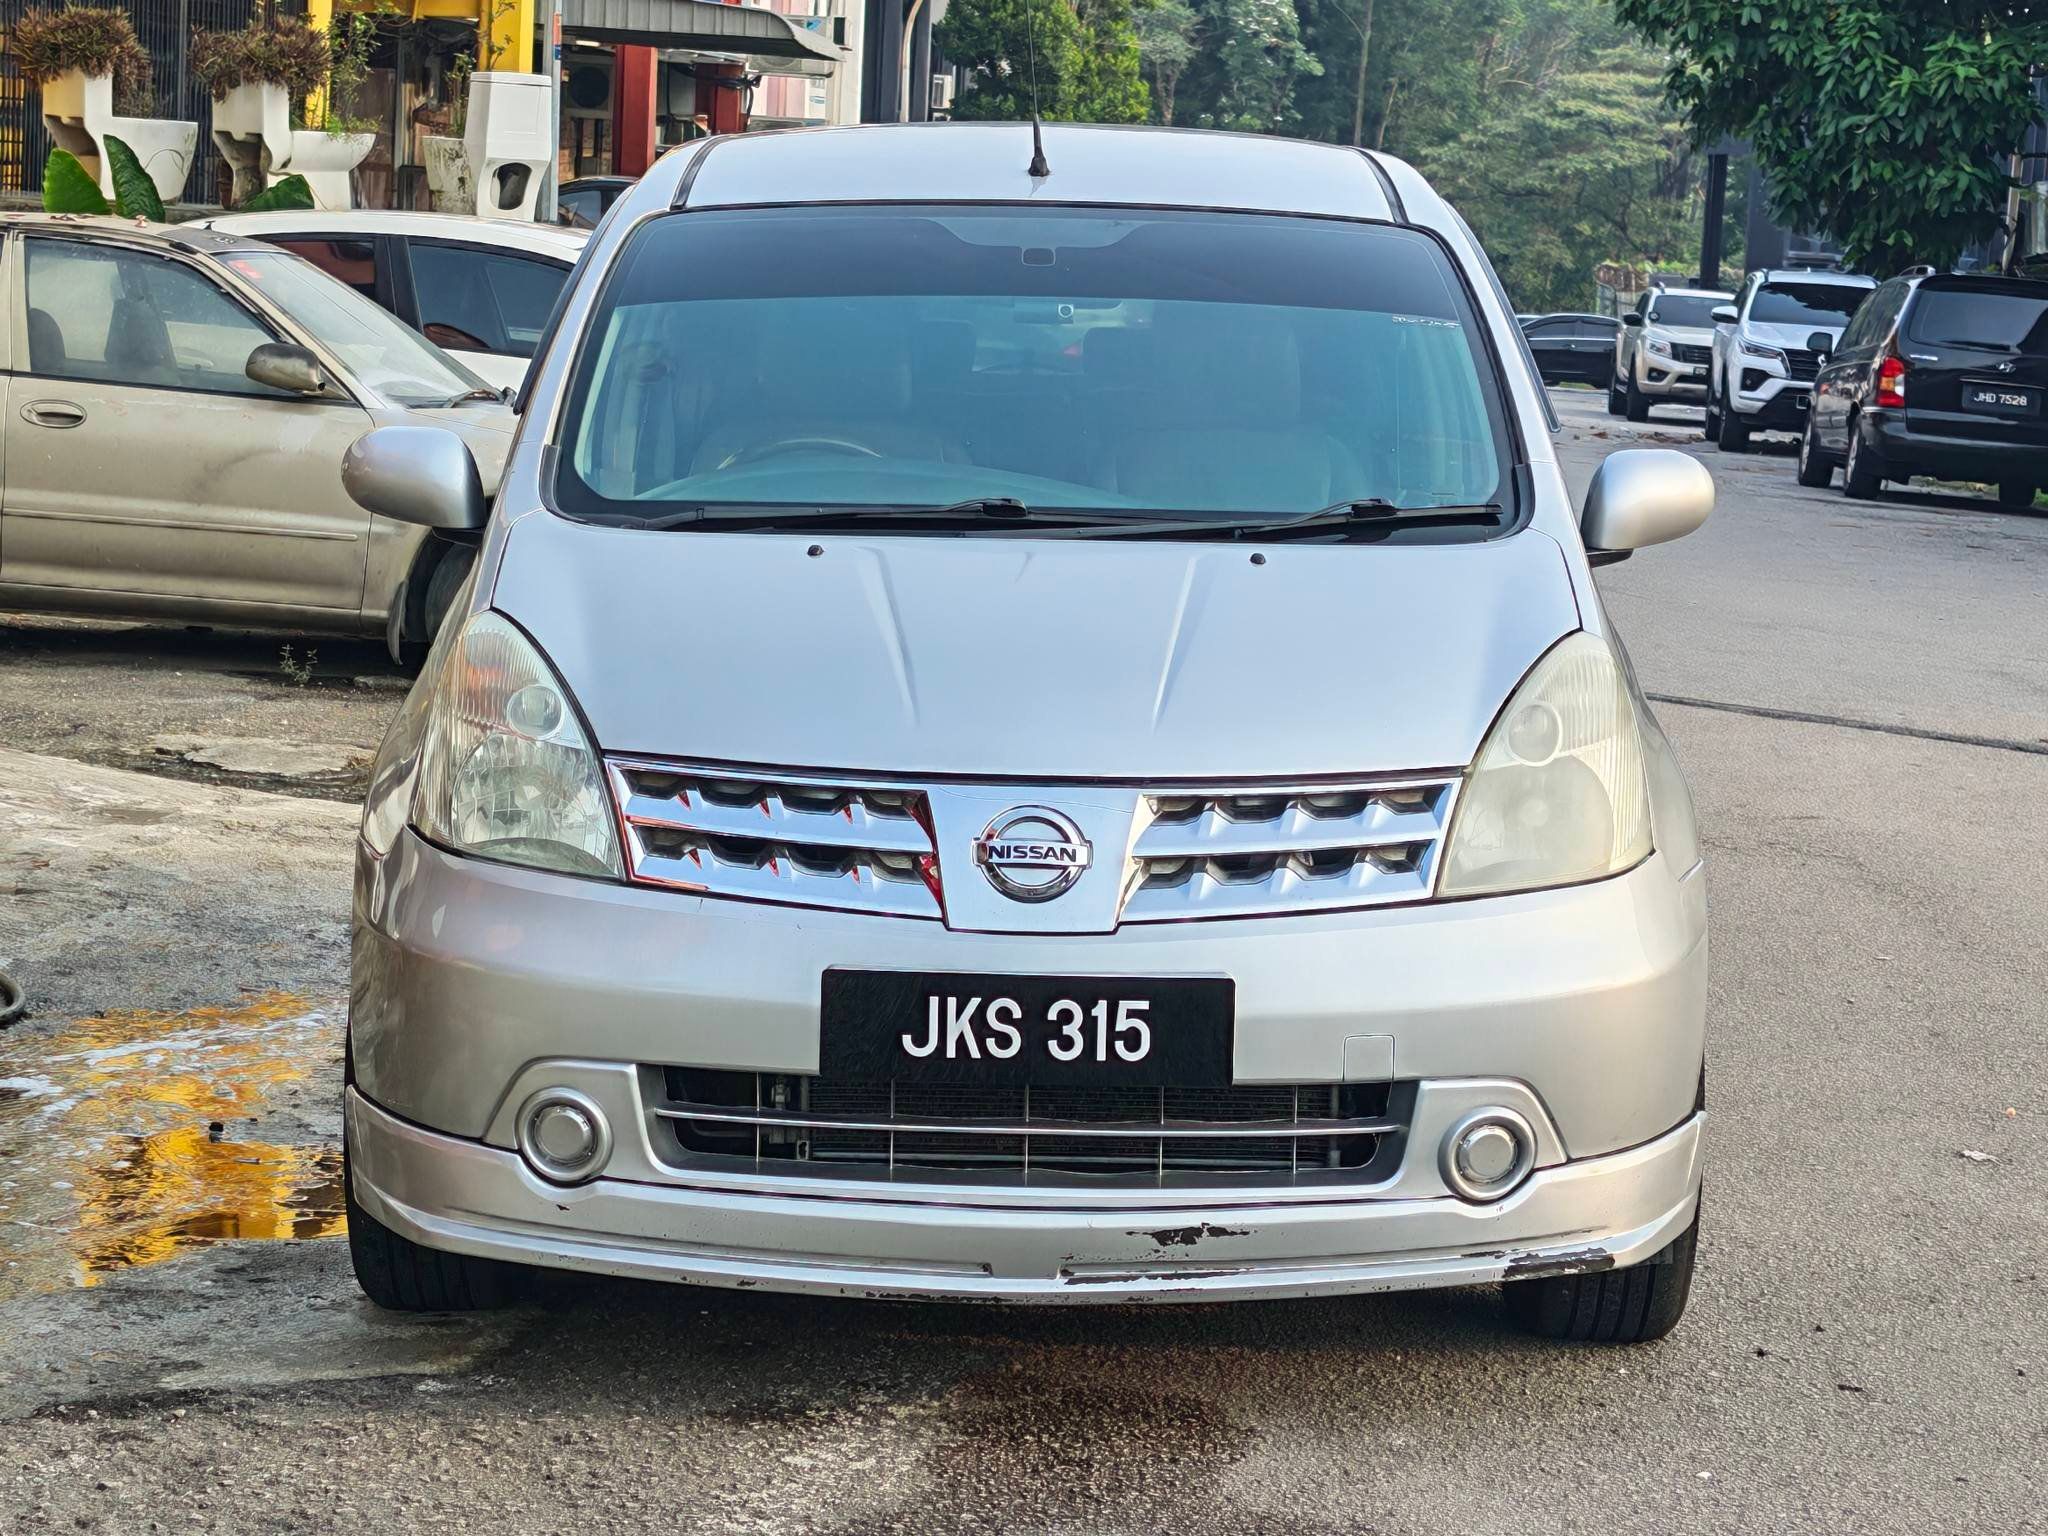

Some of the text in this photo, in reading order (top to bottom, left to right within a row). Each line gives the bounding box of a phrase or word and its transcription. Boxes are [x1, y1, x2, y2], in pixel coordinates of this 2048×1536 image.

[1974, 392, 2027, 406] JHD 7528
[988, 845, 1076, 862] NISSAN
[902, 996, 1151, 1061] JKS 315
